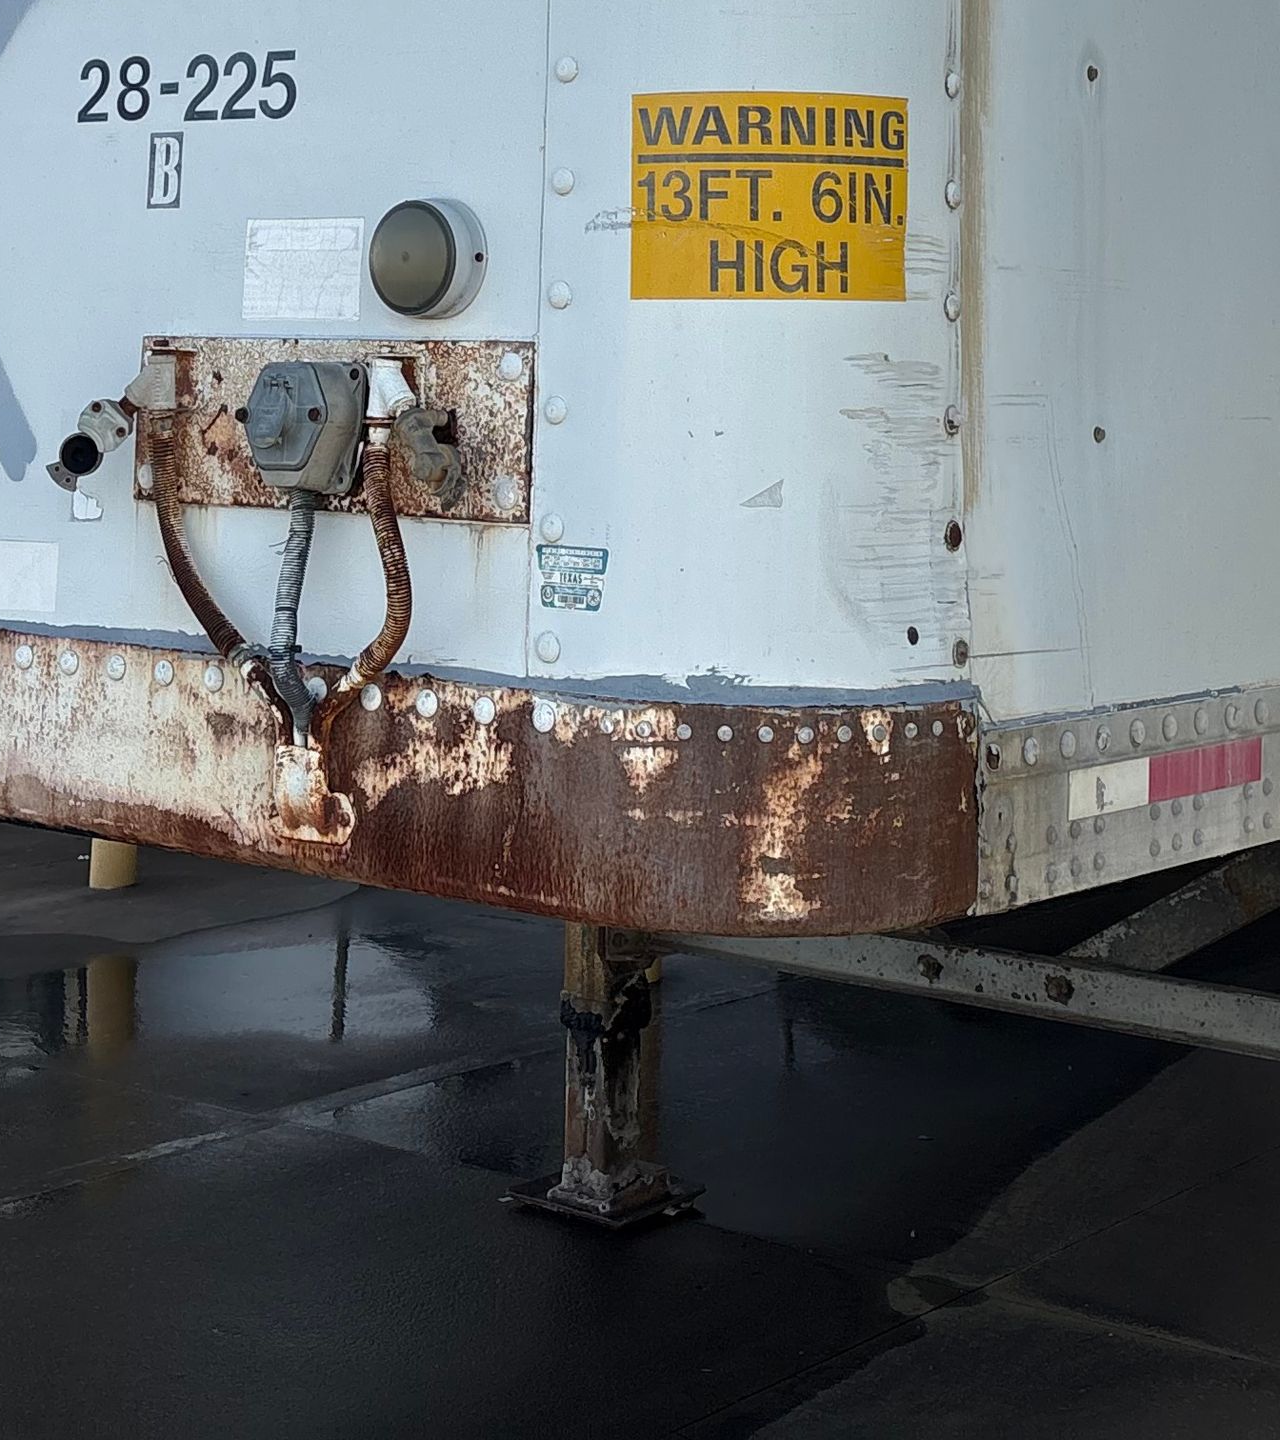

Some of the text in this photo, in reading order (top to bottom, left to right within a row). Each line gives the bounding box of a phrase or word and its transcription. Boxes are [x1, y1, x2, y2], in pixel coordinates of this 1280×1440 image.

[77, 50, 297, 123] 28-225
[637, 105, 905, 150] WARNING
[637, 169, 904, 226] 13FT. 6IN.
[709, 239, 848, 293] HIGH
[559, 572, 583, 584] TEXAS
